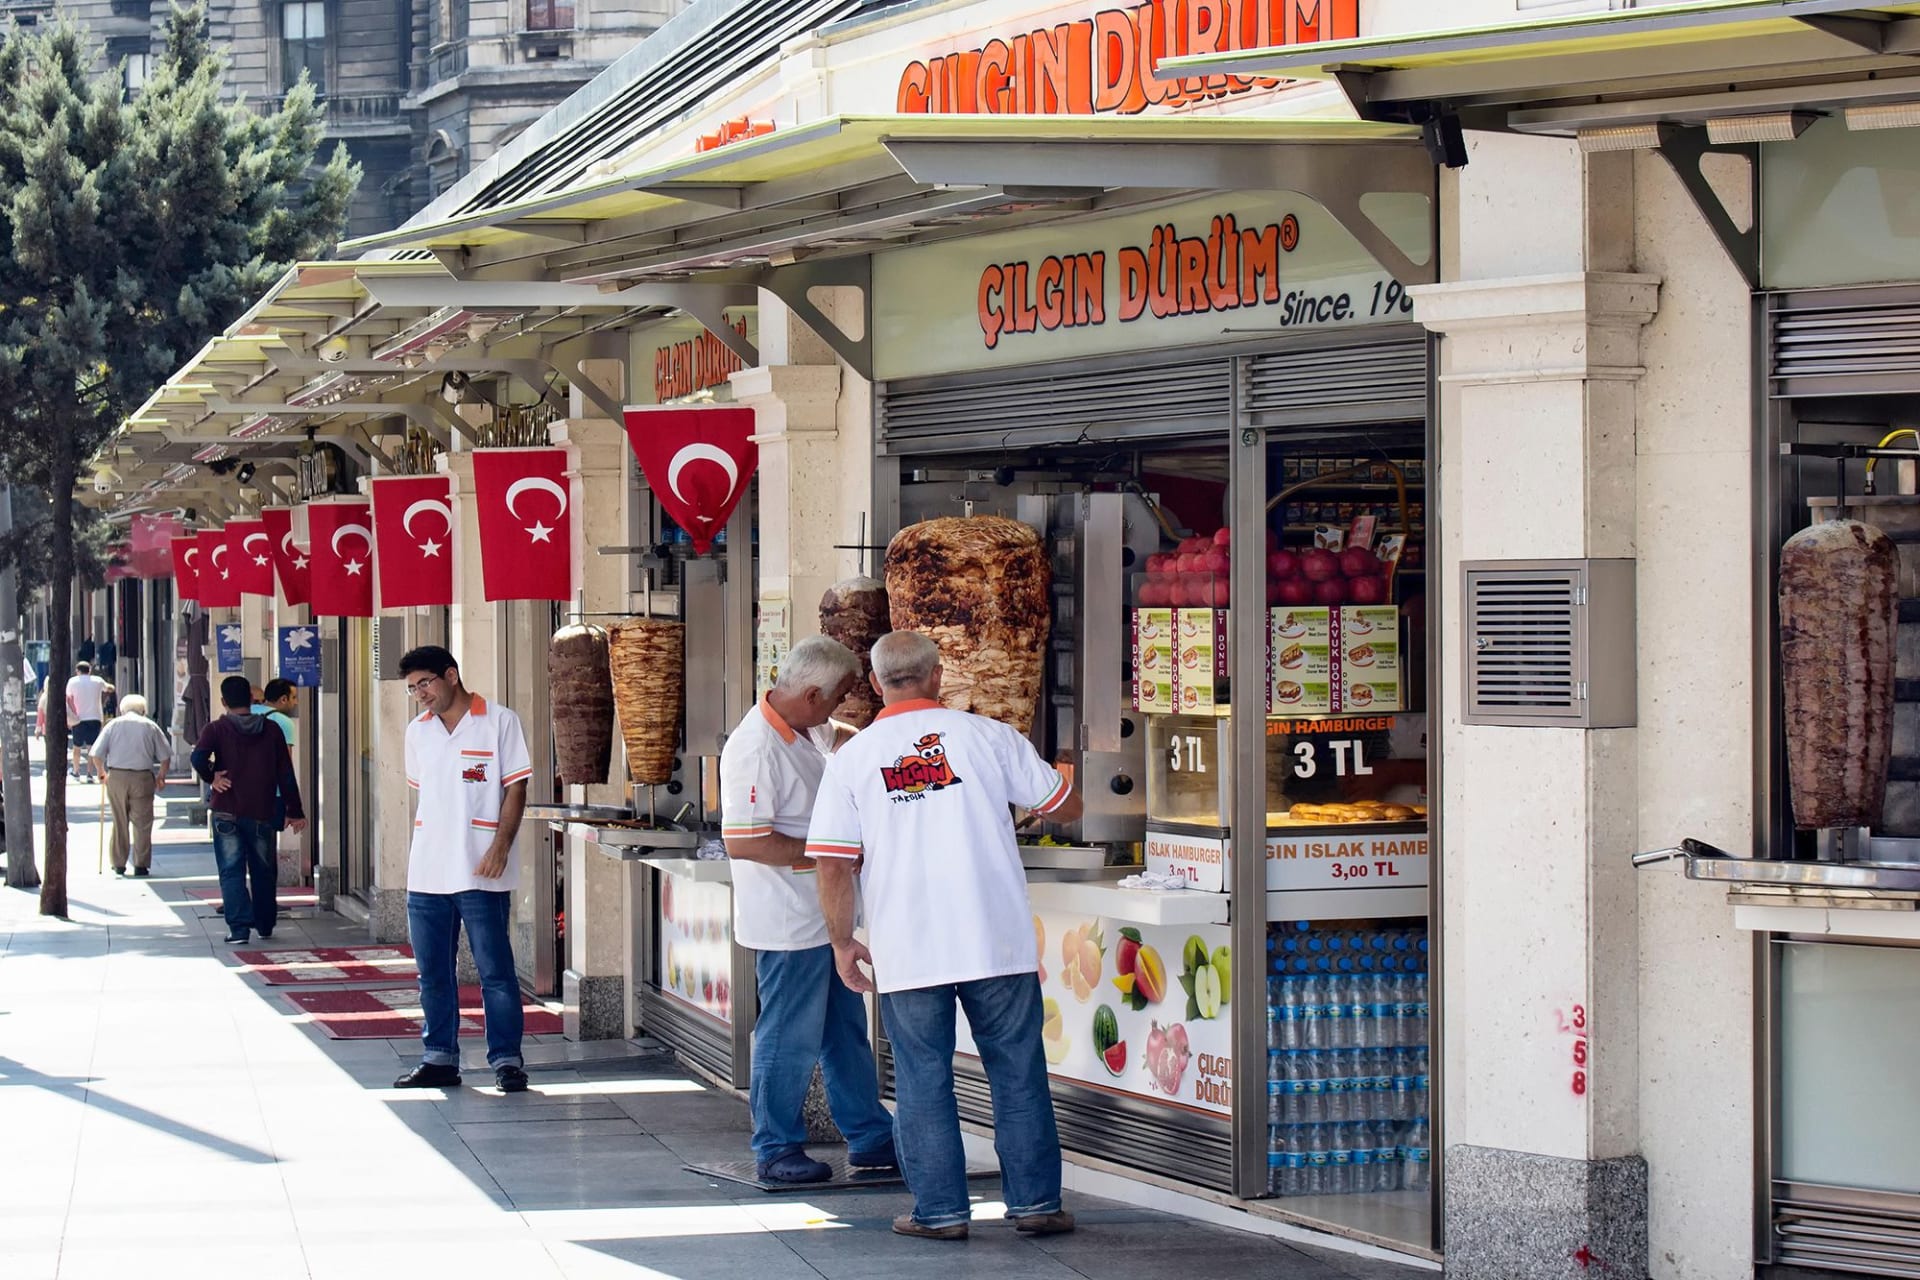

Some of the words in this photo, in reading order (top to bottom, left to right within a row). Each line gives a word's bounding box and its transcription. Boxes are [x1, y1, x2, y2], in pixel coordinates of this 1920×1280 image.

[977, 251, 1105, 350] ÇILGIN
[1280, 289, 1355, 326] Since.
[655, 340, 692, 404] ÇILGIN
[1331, 610, 1339, 657] TAVUK
[1171, 735, 1181, 771] 3
[1186, 736, 1206, 772] TL
[1294, 741, 1317, 778] 3
[1329, 740, 1373, 776] TL
[1148, 841, 1170, 857] ISLAK
[1172, 843, 1221, 864] HAMBURGER
[1304, 842, 1364, 859] ISLAK
[1187, 866, 1199, 882] TL
[1331, 863, 1368, 880] 3,00
[1374, 861, 1399, 876] TL
[1195, 1077, 1232, 1107] DÜRÜ
